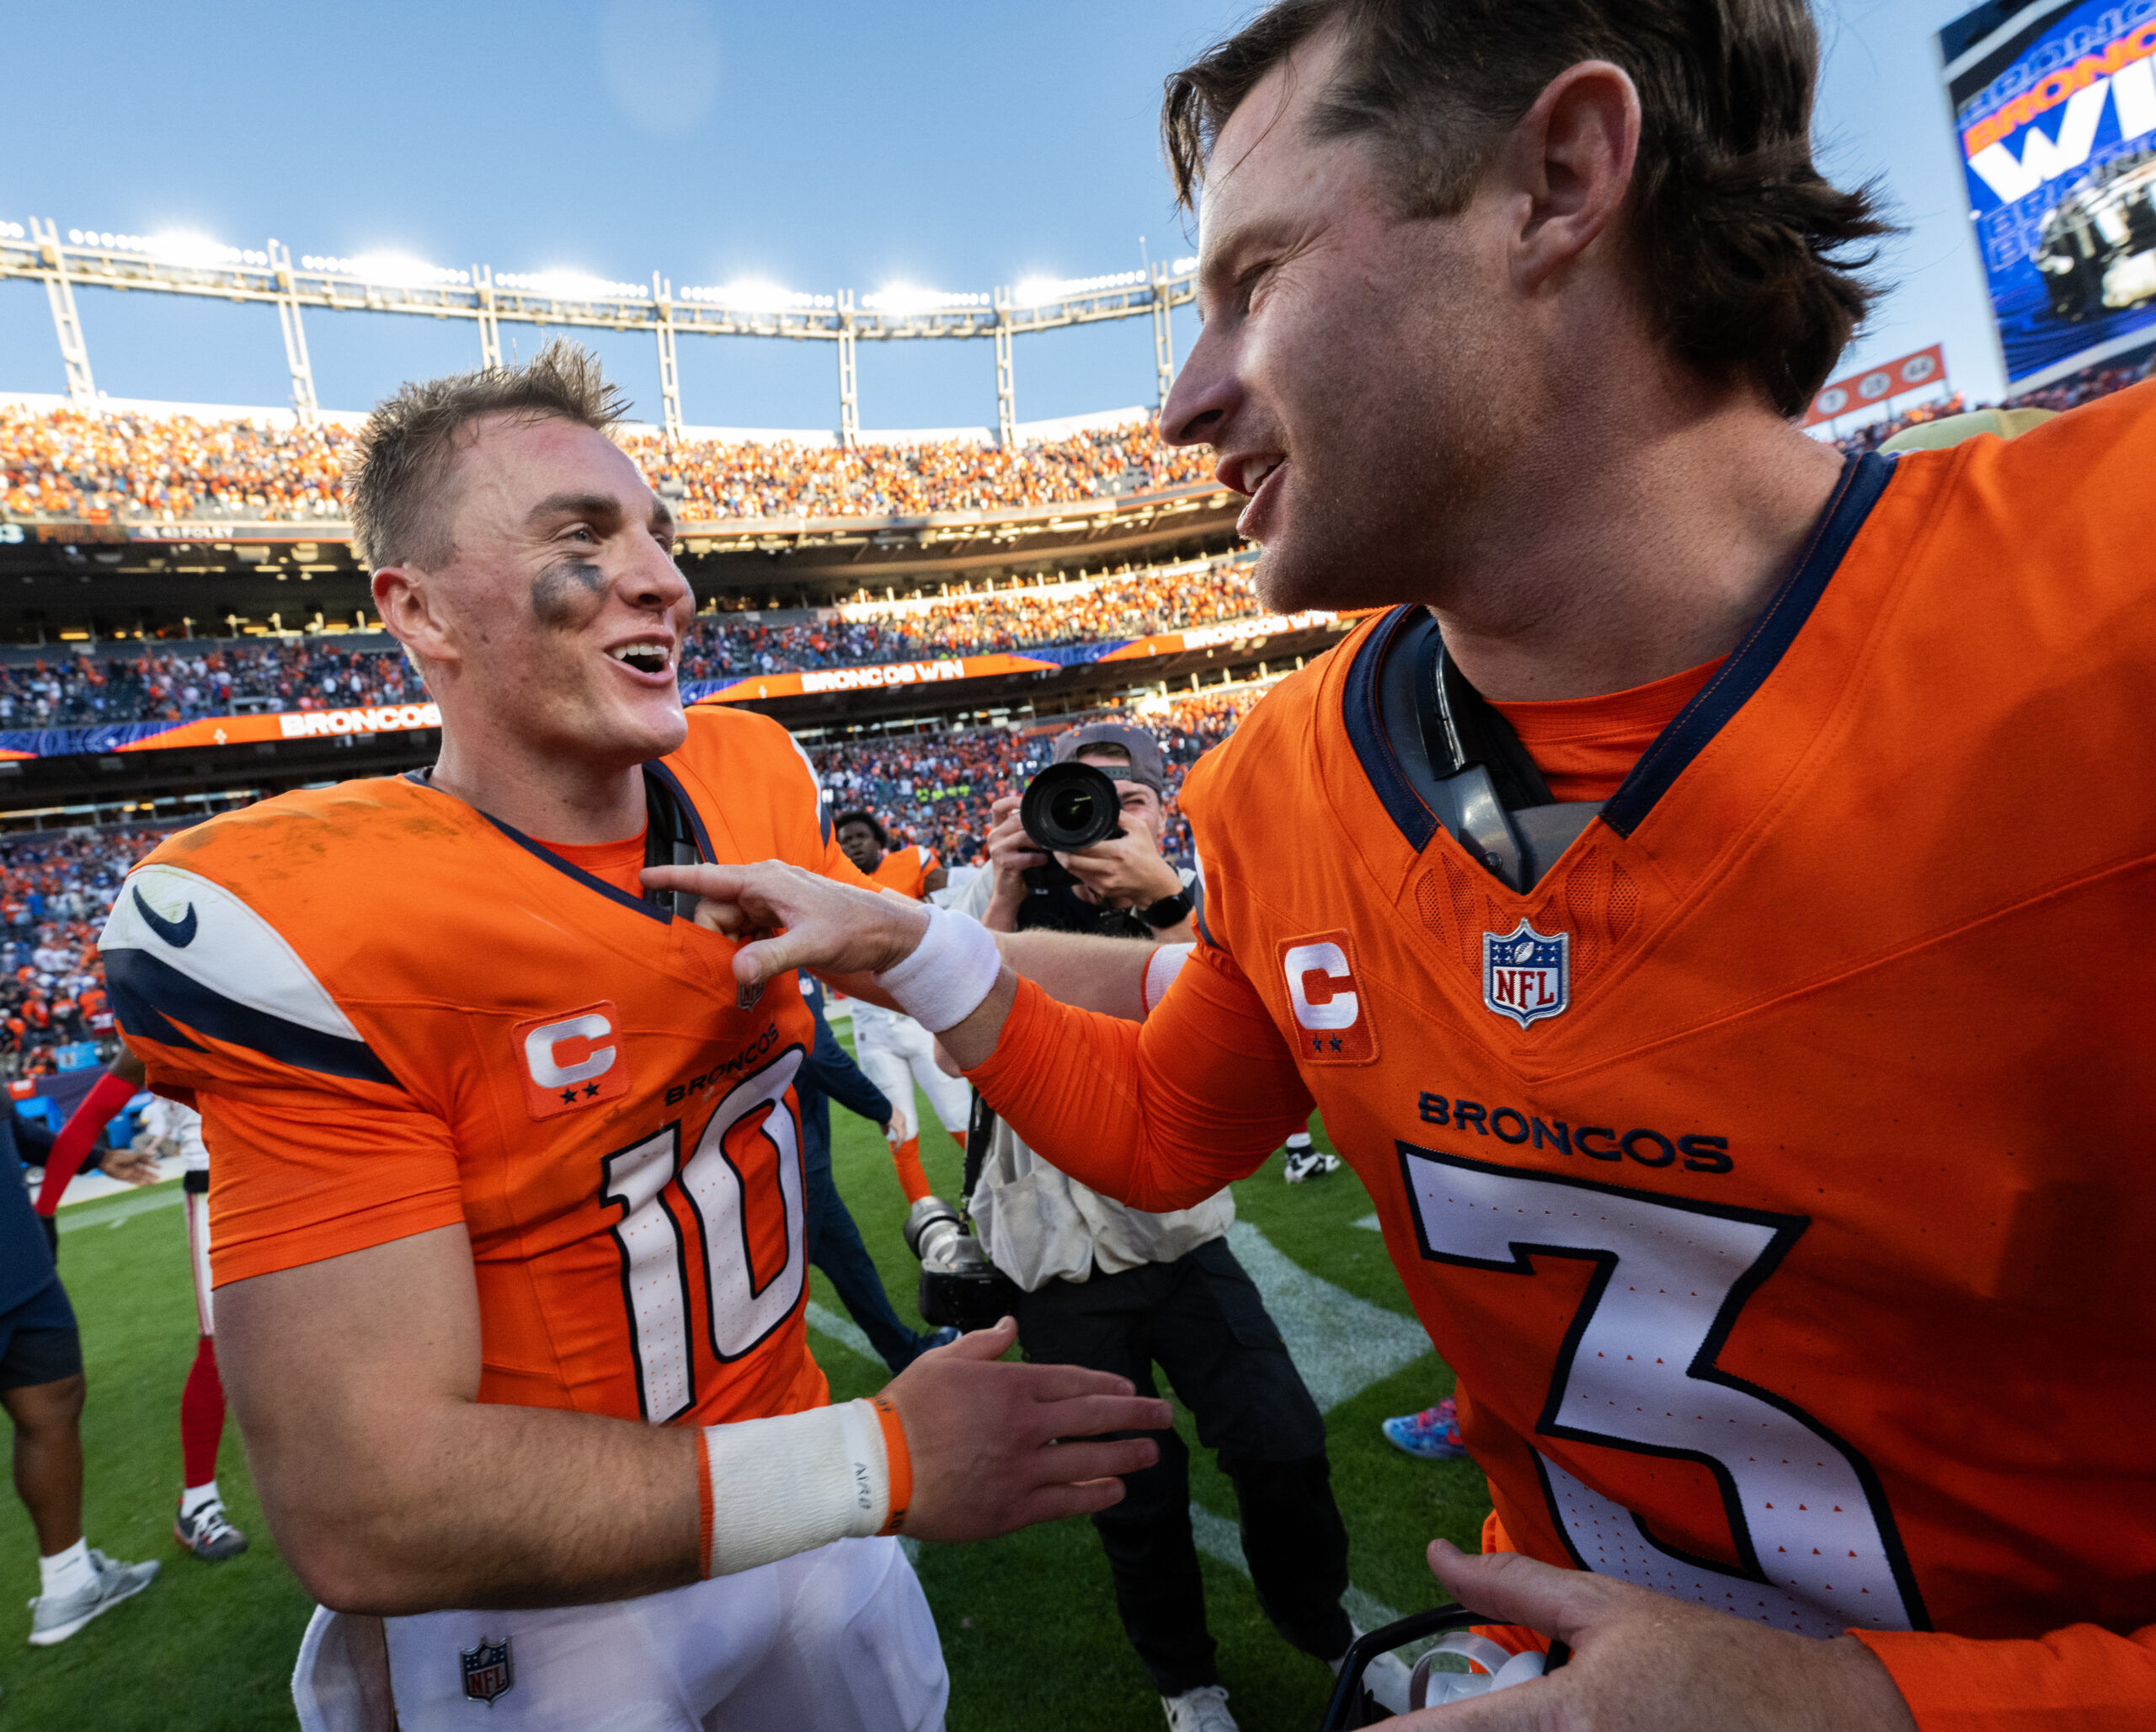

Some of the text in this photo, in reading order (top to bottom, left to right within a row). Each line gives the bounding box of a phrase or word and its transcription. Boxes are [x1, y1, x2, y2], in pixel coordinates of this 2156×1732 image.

[1967, 52, 2156, 204] WI
[801, 660, 964, 692] BRONCOS WIN
[280, 704, 442, 737] BRONCOS
[1284, 943, 1358, 1029] C
[1497, 970, 1555, 1009] NFL
[525, 1013, 616, 1088] C
[664, 1022, 779, 1107] BRONCOS
[1418, 1091, 1733, 1173] BRONCOS
[600, 1042, 807, 1426] 10
[1395, 1139, 1935, 1641] 3
[468, 1665, 505, 1695] NFL
